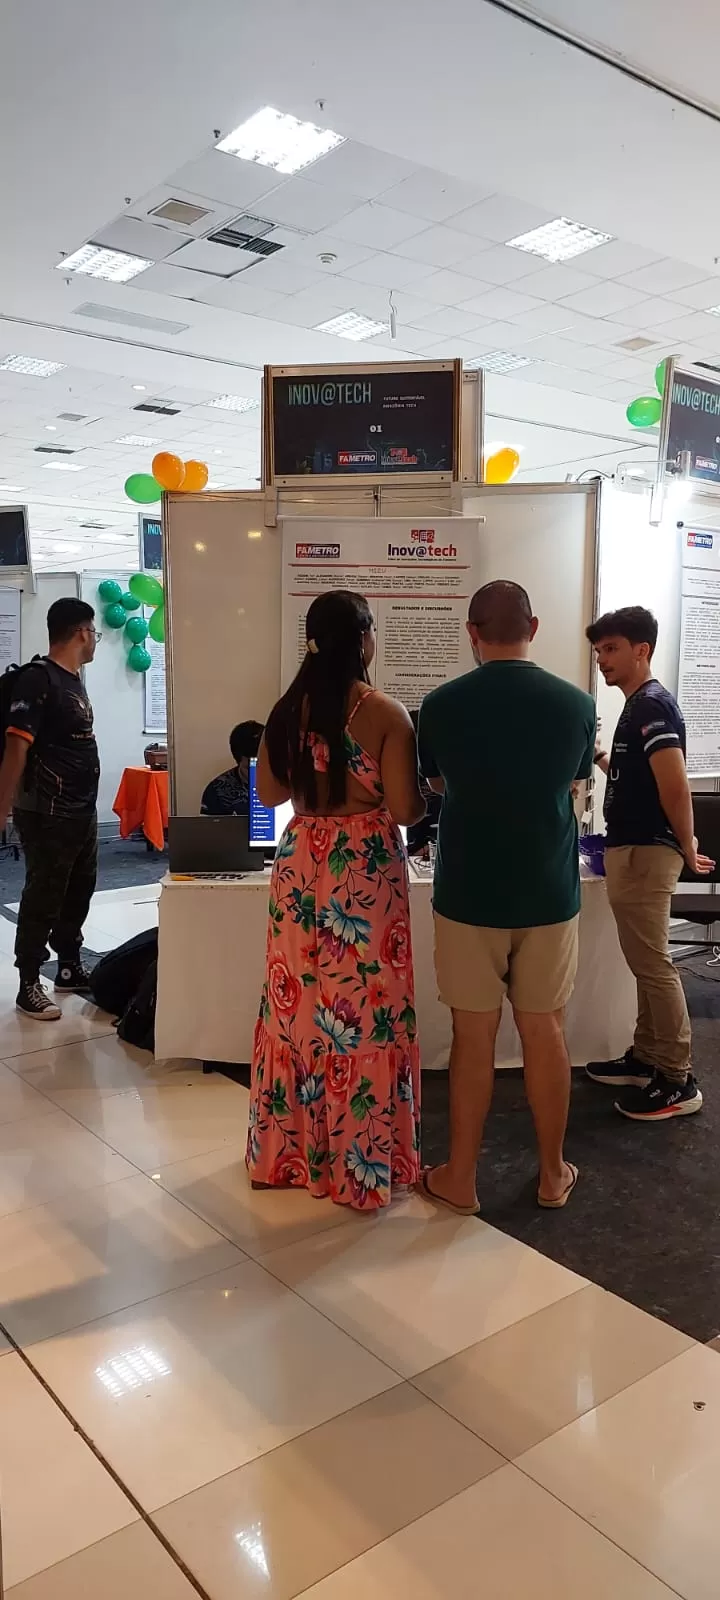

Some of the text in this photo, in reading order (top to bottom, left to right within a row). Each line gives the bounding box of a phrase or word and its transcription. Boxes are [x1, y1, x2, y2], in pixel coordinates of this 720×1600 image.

[288, 382, 372, 406] INOV@TECH
[369, 425, 382, 433] 01
[339, 453, 376, 464] FAMETRO
[296, 546, 339, 555] FAMETRO
[388, 544, 457, 558] Inov@tech
